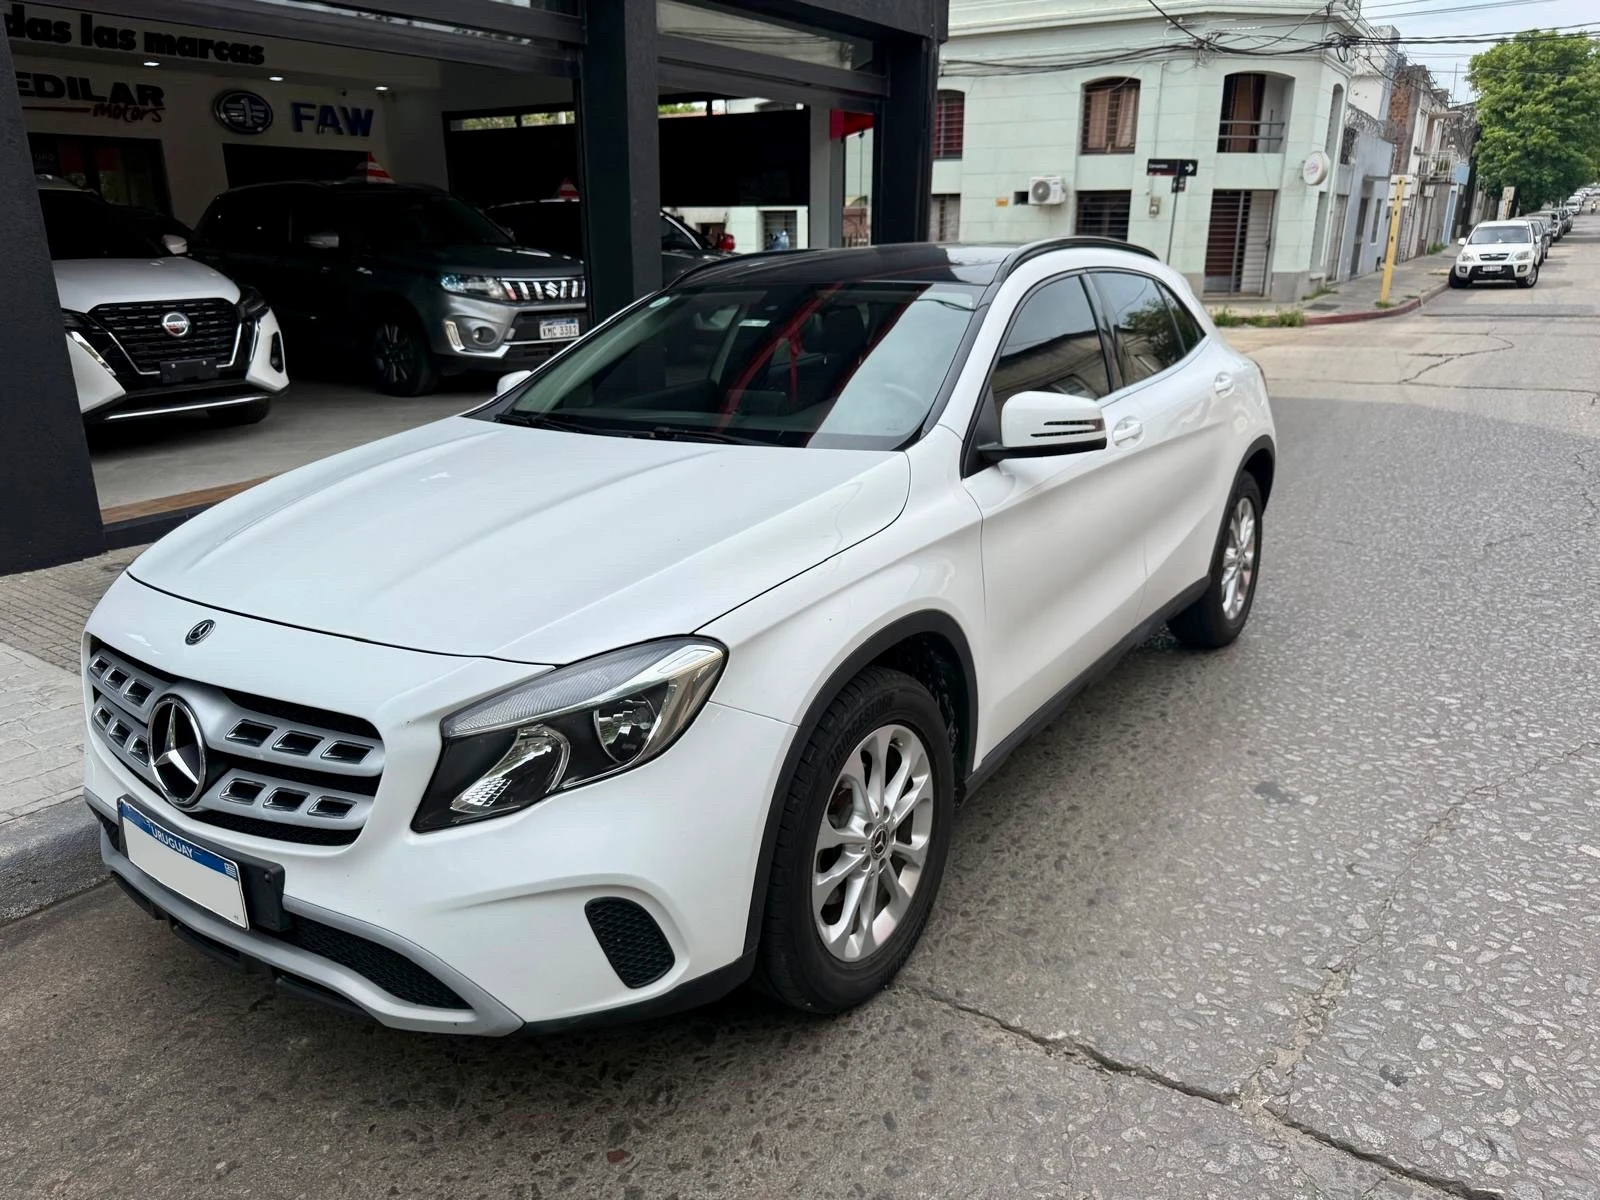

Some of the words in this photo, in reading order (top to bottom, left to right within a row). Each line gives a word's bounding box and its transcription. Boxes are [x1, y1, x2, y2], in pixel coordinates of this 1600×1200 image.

[80, 13, 137, 51] las
[144, 31, 265, 65] marcas
[93, 102, 165, 123] motors
[291, 102, 374, 137] FAW
[150, 825, 194, 859] URUGUAY
